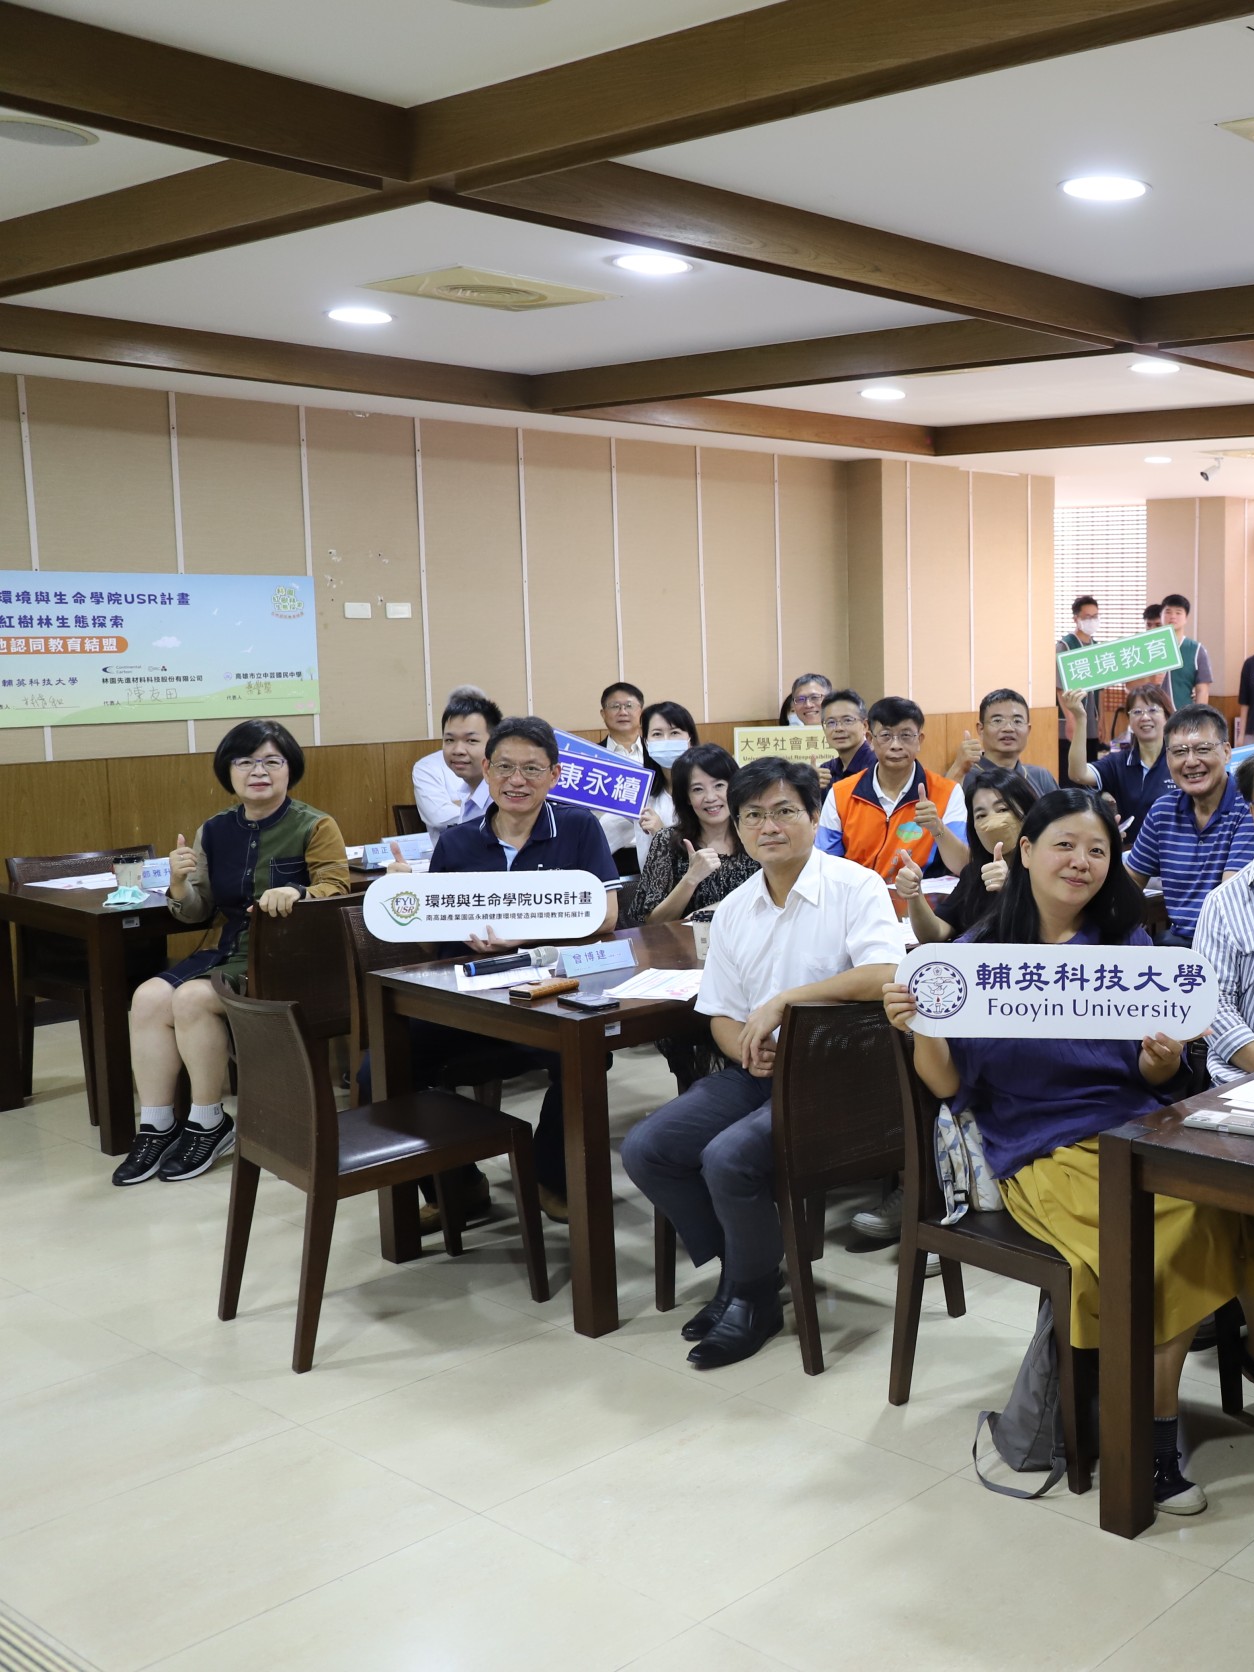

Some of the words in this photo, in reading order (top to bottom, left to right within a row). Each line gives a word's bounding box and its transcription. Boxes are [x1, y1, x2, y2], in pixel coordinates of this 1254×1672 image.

[0, 590, 191, 606] 環境與生命學院USR計畫
[0, 614, 124, 628] 紅樹林生態探索
[1067, 638, 1168, 681] 環境教育
[395, 896, 416, 906] FYU
[425, 891, 593, 909] 環境與生命學院USR計畫
[396, 906, 415, 914] USR
[975, 962, 1207, 994] 輔英科技大學
[988, 998, 1064, 1022] Fooyin
[1072, 998, 1192, 1024] University
